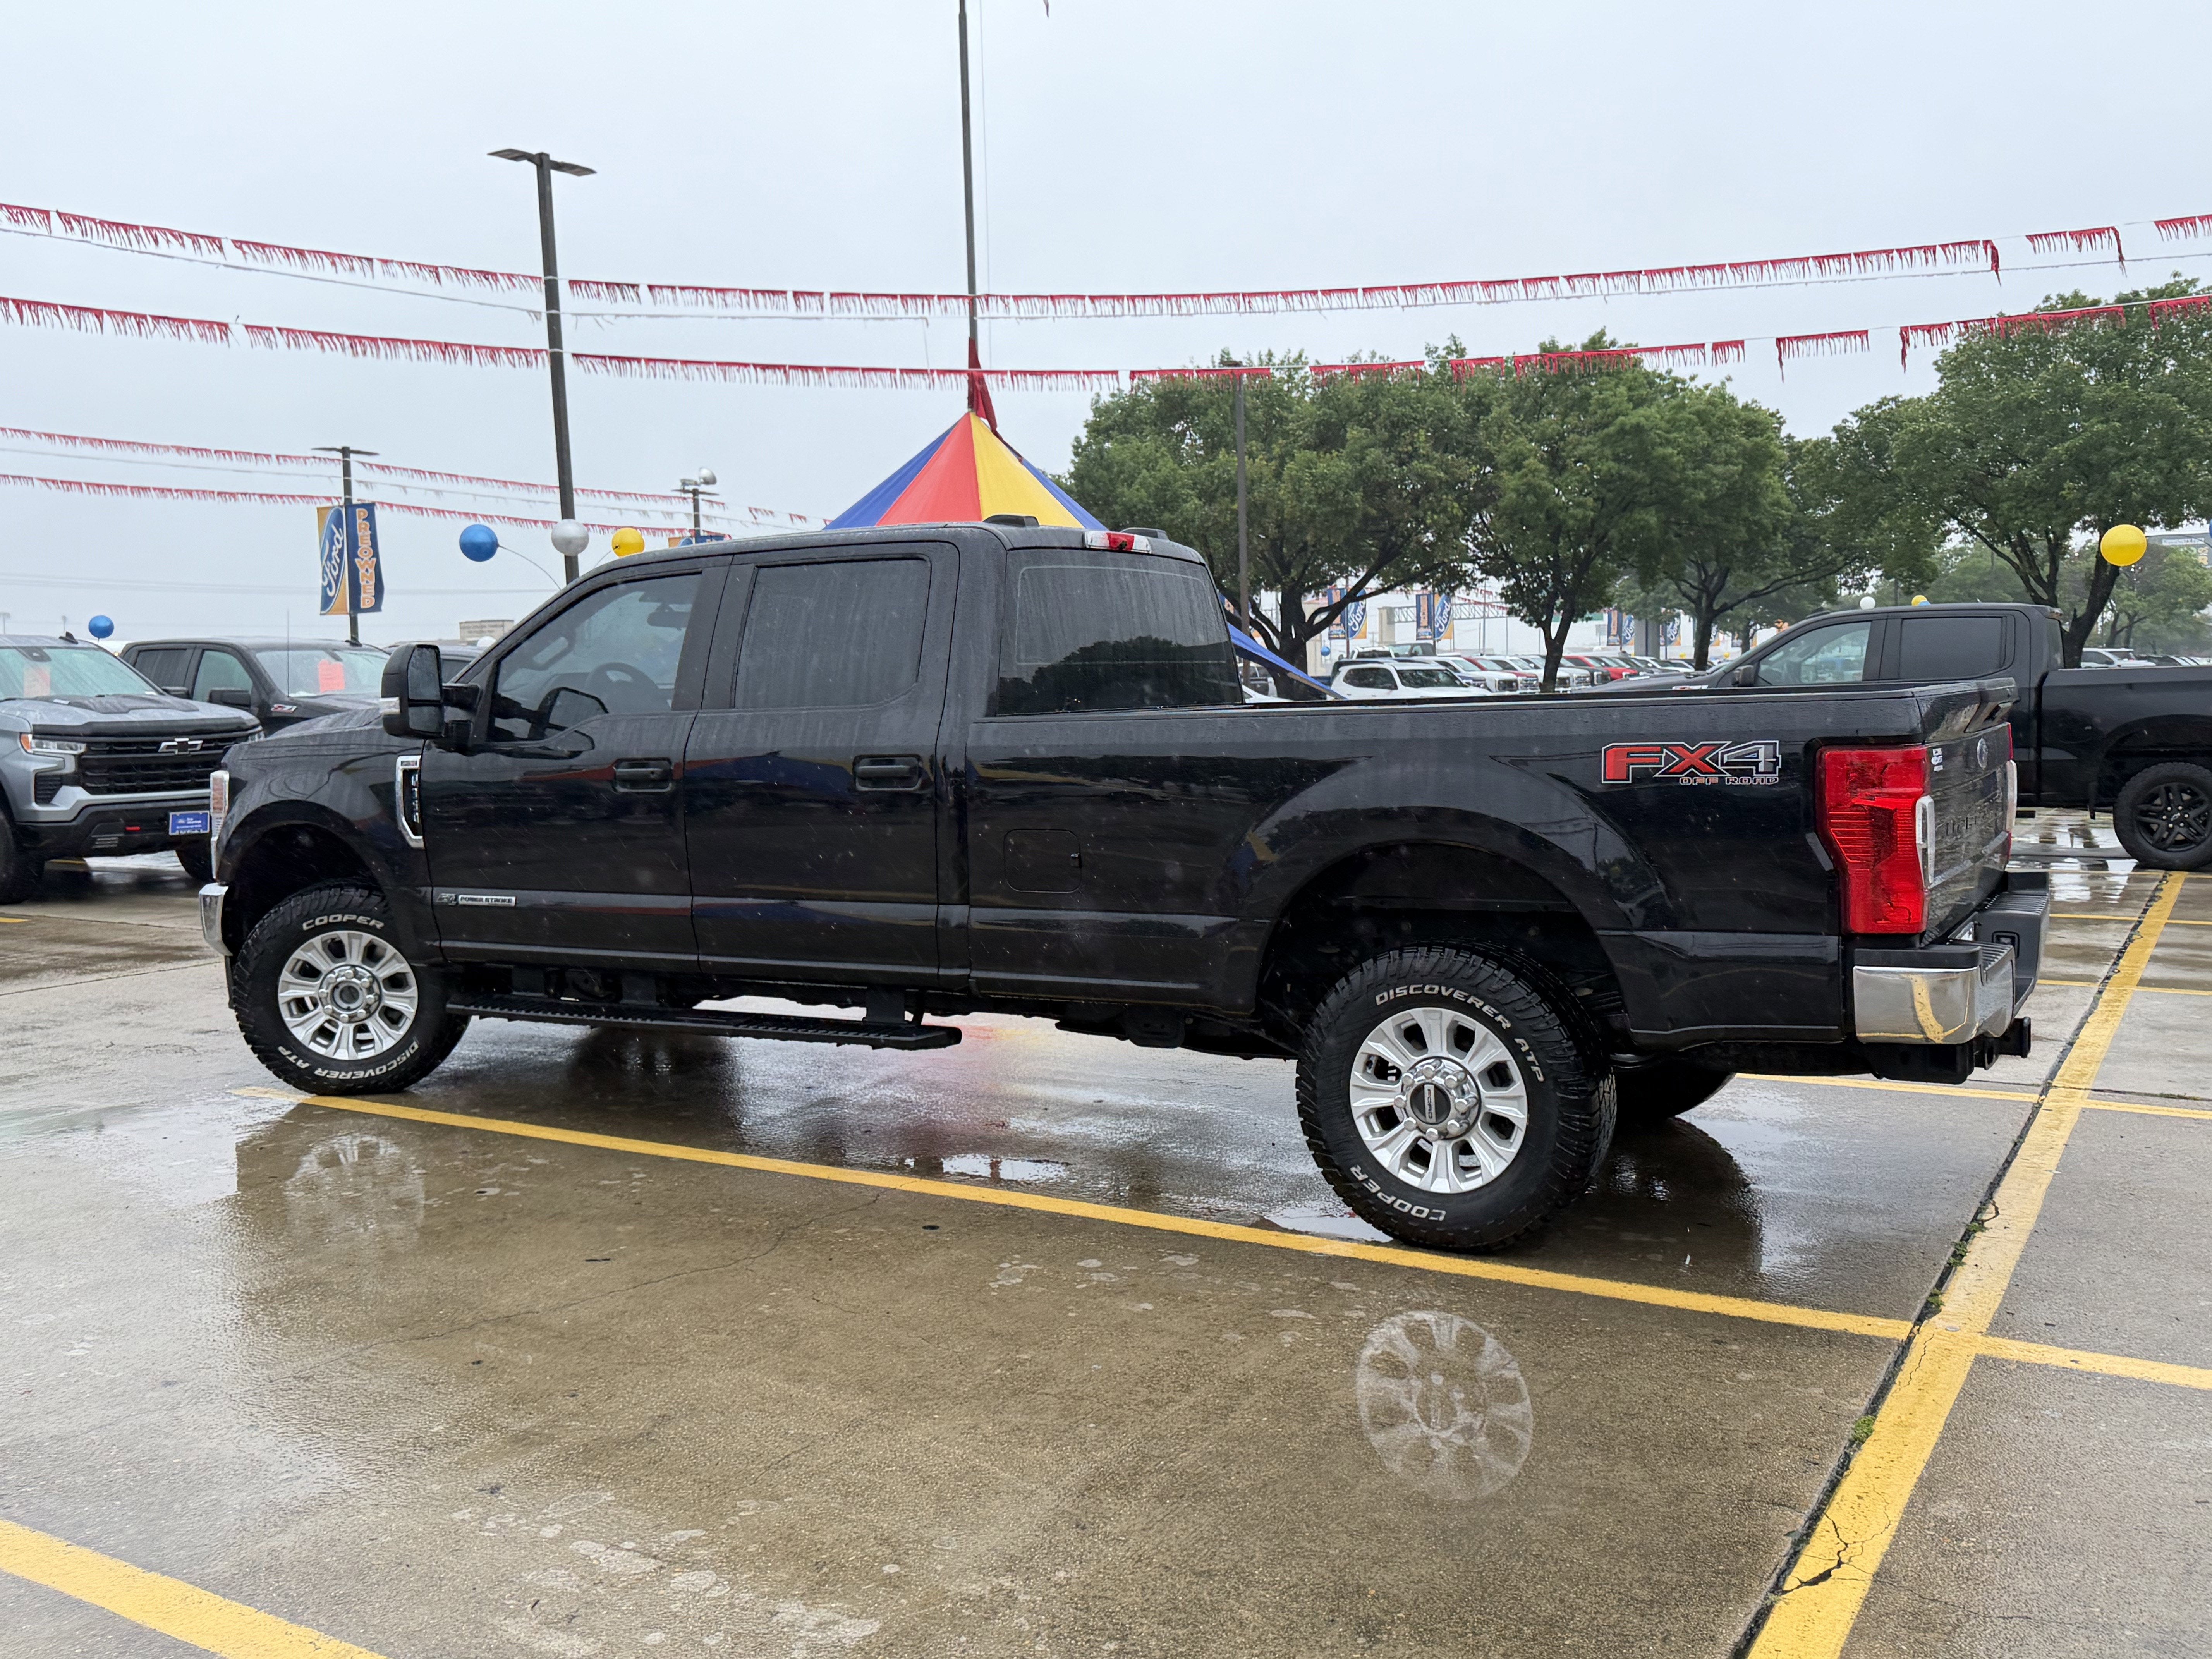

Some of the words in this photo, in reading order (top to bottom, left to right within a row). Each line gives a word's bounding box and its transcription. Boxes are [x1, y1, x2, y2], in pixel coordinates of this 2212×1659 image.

[322, 524, 343, 597] Ford
[355, 508, 376, 608] PREOWNED
[1435, 599, 1451, 632] Ford
[1602, 740, 1781, 783] FX4
[1680, 777, 1719, 785] OFF
[1725, 777, 1779, 785] ROAD
[302, 914, 385, 931] COOPER
[1375, 984, 1511, 1029] DISCOVERER
[1514, 1038, 1544, 1082] ATP
[278, 1046, 311, 1069] ATP
[314, 1041, 419, 1079] DISCOVERER
[1350, 1164, 1446, 1221] COOPER
